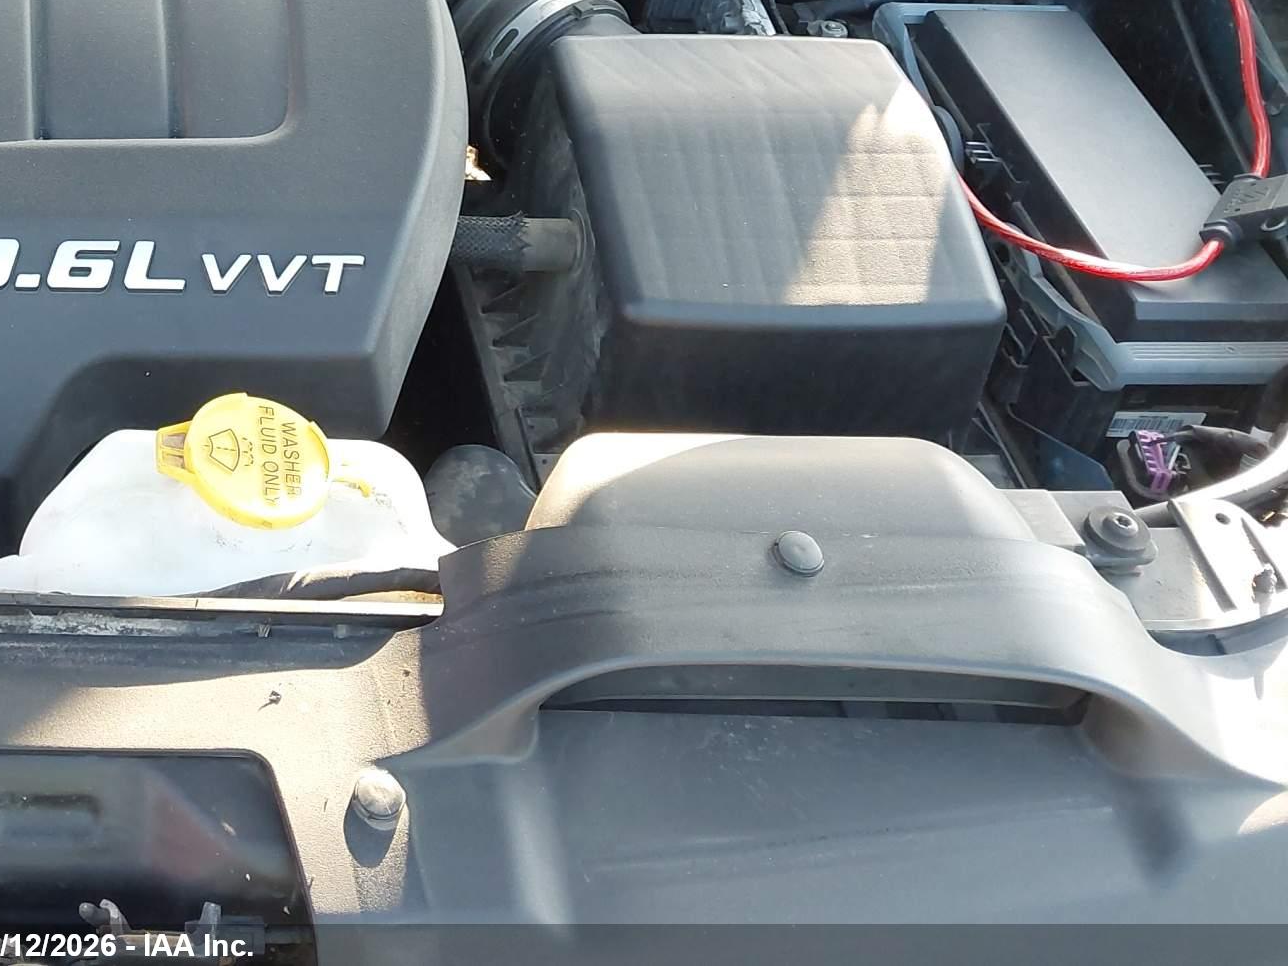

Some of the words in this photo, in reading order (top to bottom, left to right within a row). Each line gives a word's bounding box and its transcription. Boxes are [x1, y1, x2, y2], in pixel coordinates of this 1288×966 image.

[201, 253, 366, 296] VVT
[258, 405, 277, 455] FLUID
[280, 421, 303, 498] WASHER
[261, 461, 281, 506] ONLY
